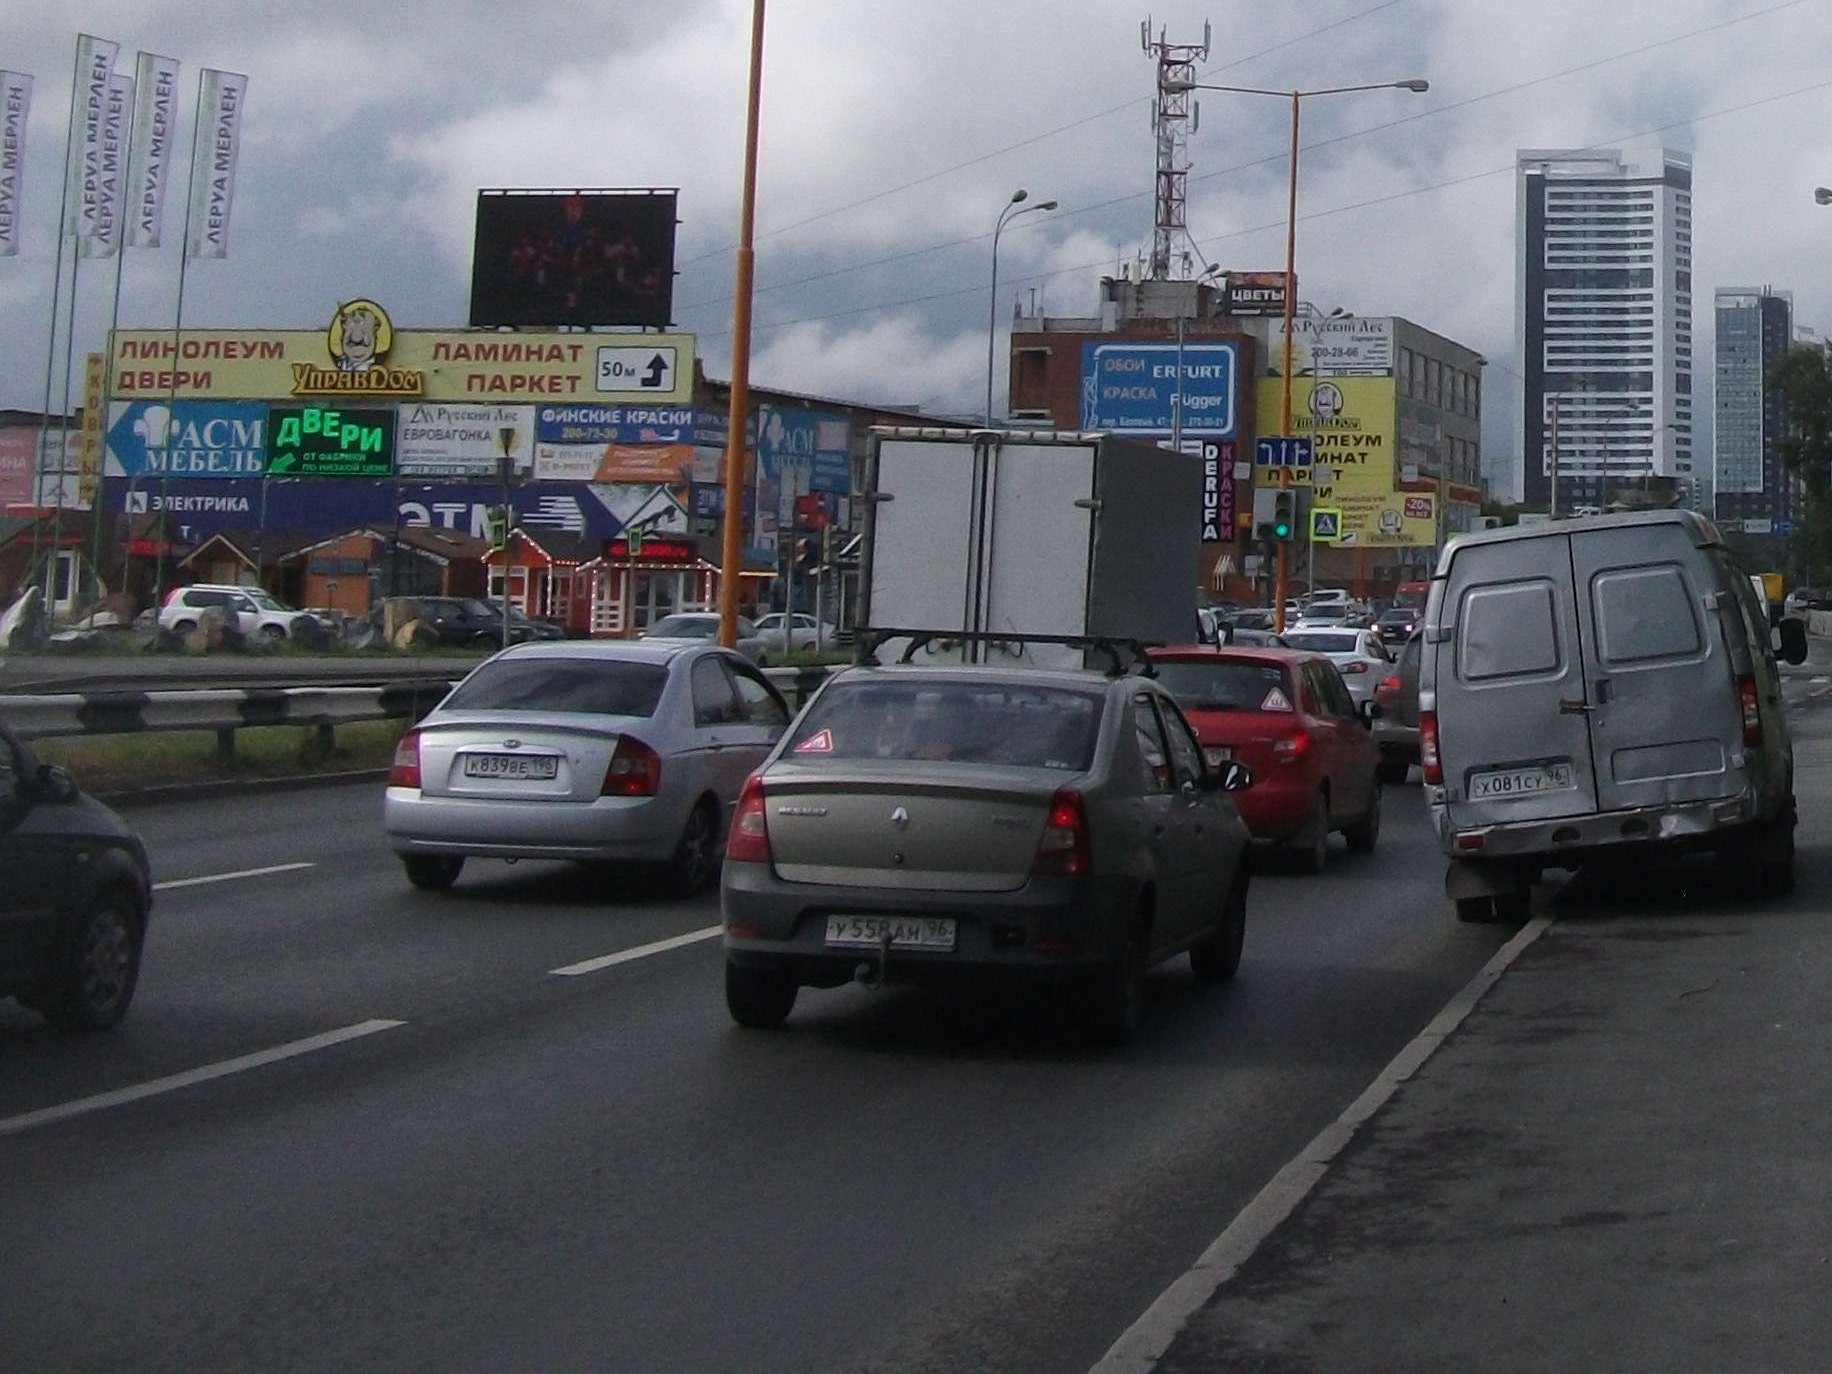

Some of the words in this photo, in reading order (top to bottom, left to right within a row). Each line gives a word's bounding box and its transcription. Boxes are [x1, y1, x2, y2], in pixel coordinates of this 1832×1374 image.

[1231, 289, 1285, 302] ЦВЕТЫ
[120, 340, 285, 360] ЛИНОЛЕУМ
[432, 343, 584, 363] ЛАМИНАТ
[1104, 358, 1145, 372] ОБОИ
[1152, 365, 1223, 379] ERFURT
[117, 371, 213, 391] ДВЕРИ
[466, 375, 581, 394] ПАРКЕТ
[1103, 386, 1157, 400] КРАСКА
[542, 409, 621, 423] ФИНСКИЕ
[626, 411, 692, 425] КРАСКИ
[178, 418, 263, 448] АСМ
[277, 409, 382, 452] ДВЕРИ
[403, 428, 492, 441] ЕВРОВАГОНКА
[1306, 434, 1382, 447] ОЛЕУМ
[145, 450, 263, 473] МЕБЕЛЬ
[1315, 452, 1368, 464] ИНАТ
[1203, 444, 1218, 539] DERUFA
[152, 496, 249, 512] ЭЛЕКТРИКА
